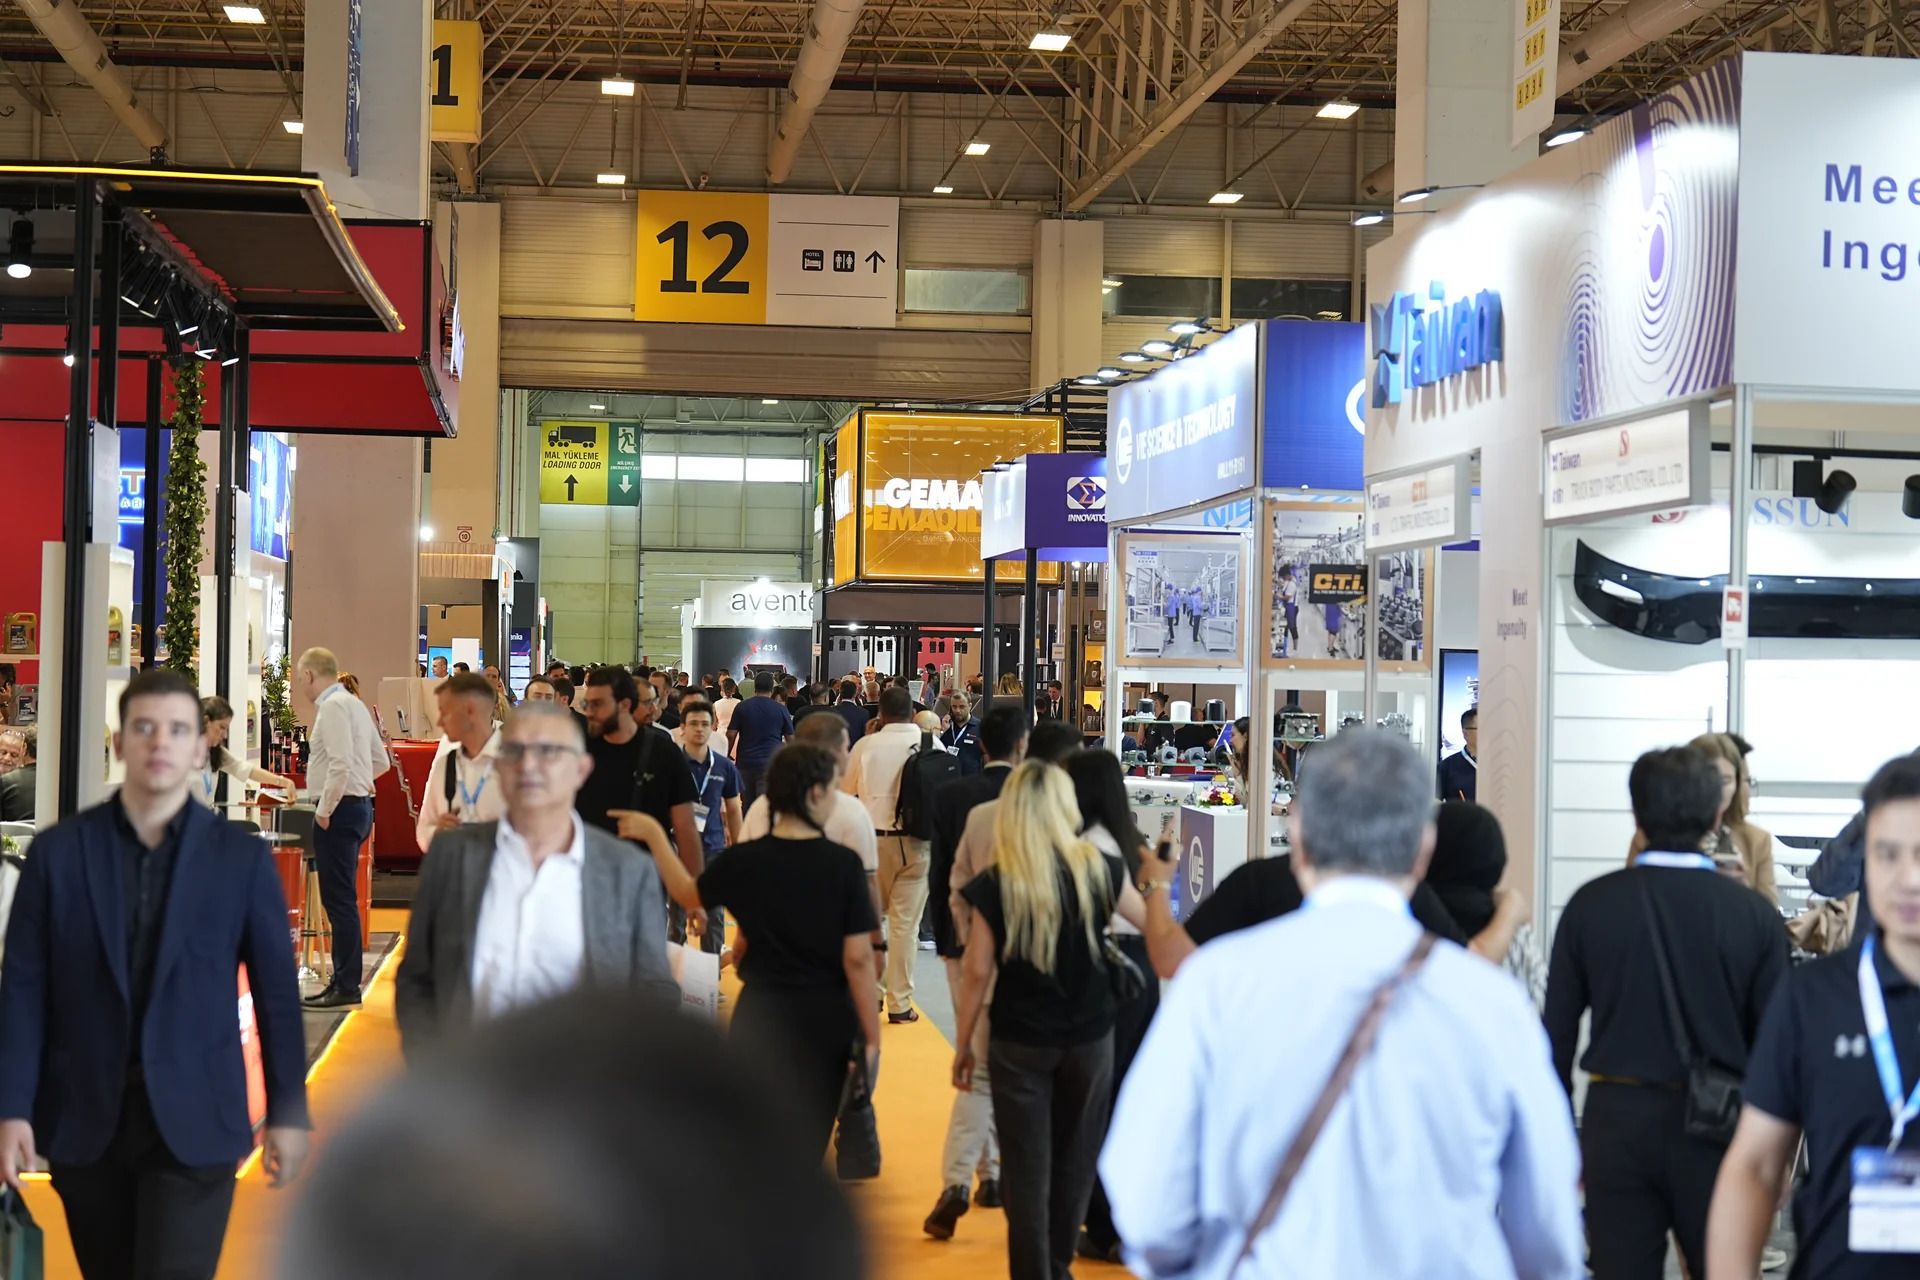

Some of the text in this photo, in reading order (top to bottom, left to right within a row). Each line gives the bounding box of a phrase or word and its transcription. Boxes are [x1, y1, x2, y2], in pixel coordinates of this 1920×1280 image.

[656, 220, 750, 294] 12
[1823, 230, 1920, 282] Ing
[1400, 280, 1503, 389] Taiwan
[543, 460, 601, 470] LOADING DOOR
[544, 450, 599, 460] MAL YÜKLEME
